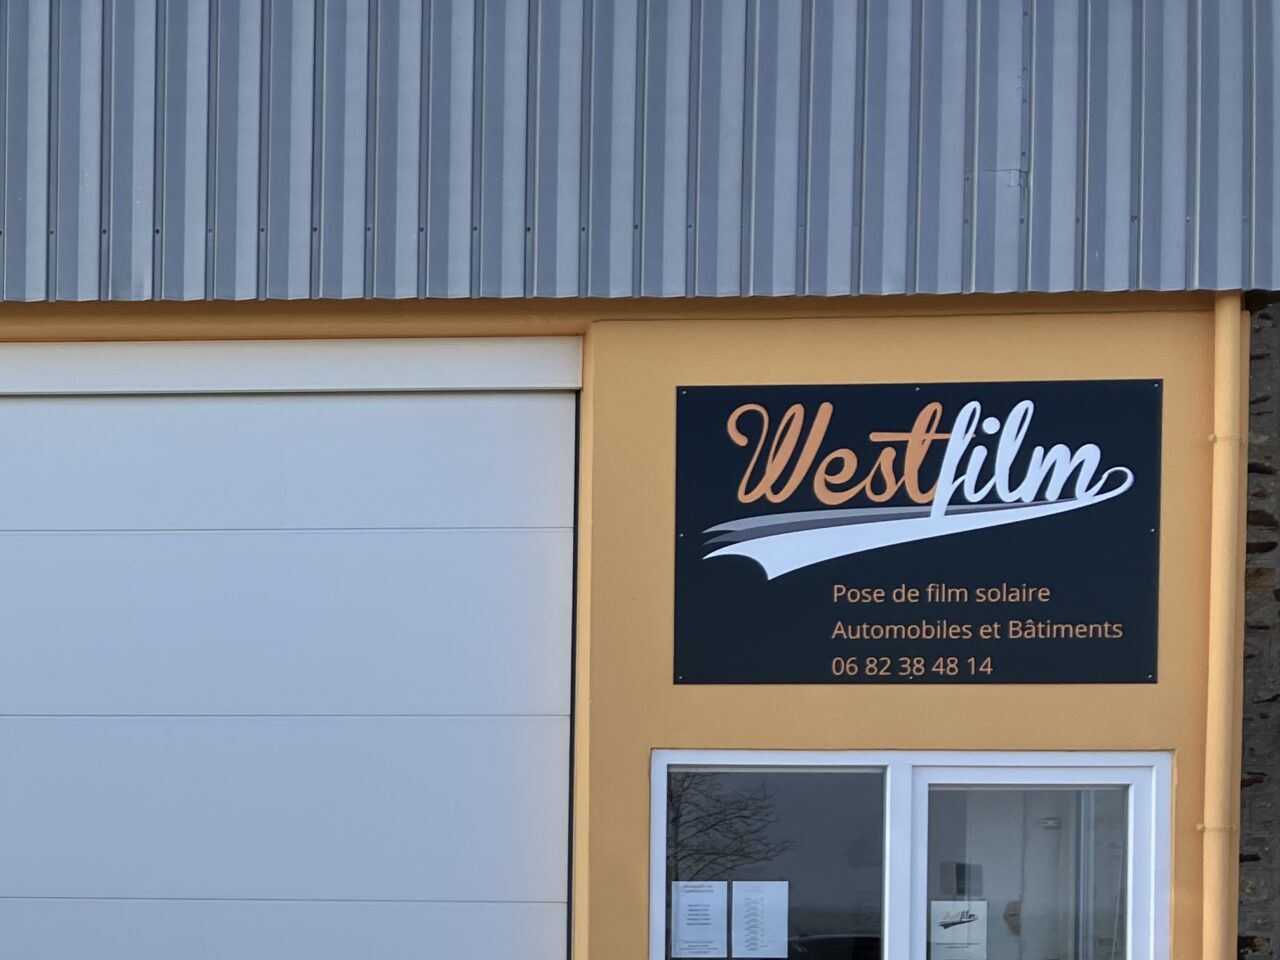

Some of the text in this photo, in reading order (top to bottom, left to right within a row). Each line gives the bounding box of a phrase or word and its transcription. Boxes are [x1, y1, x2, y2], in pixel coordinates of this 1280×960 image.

[727, 400, 1134, 510] Westfilm
[832, 583, 1051, 603] Pose de film solaire
[831, 620, 1124, 639] Automobiles et Bâtiments
[831, 656, 993, 676] 06 82 38 48 14
